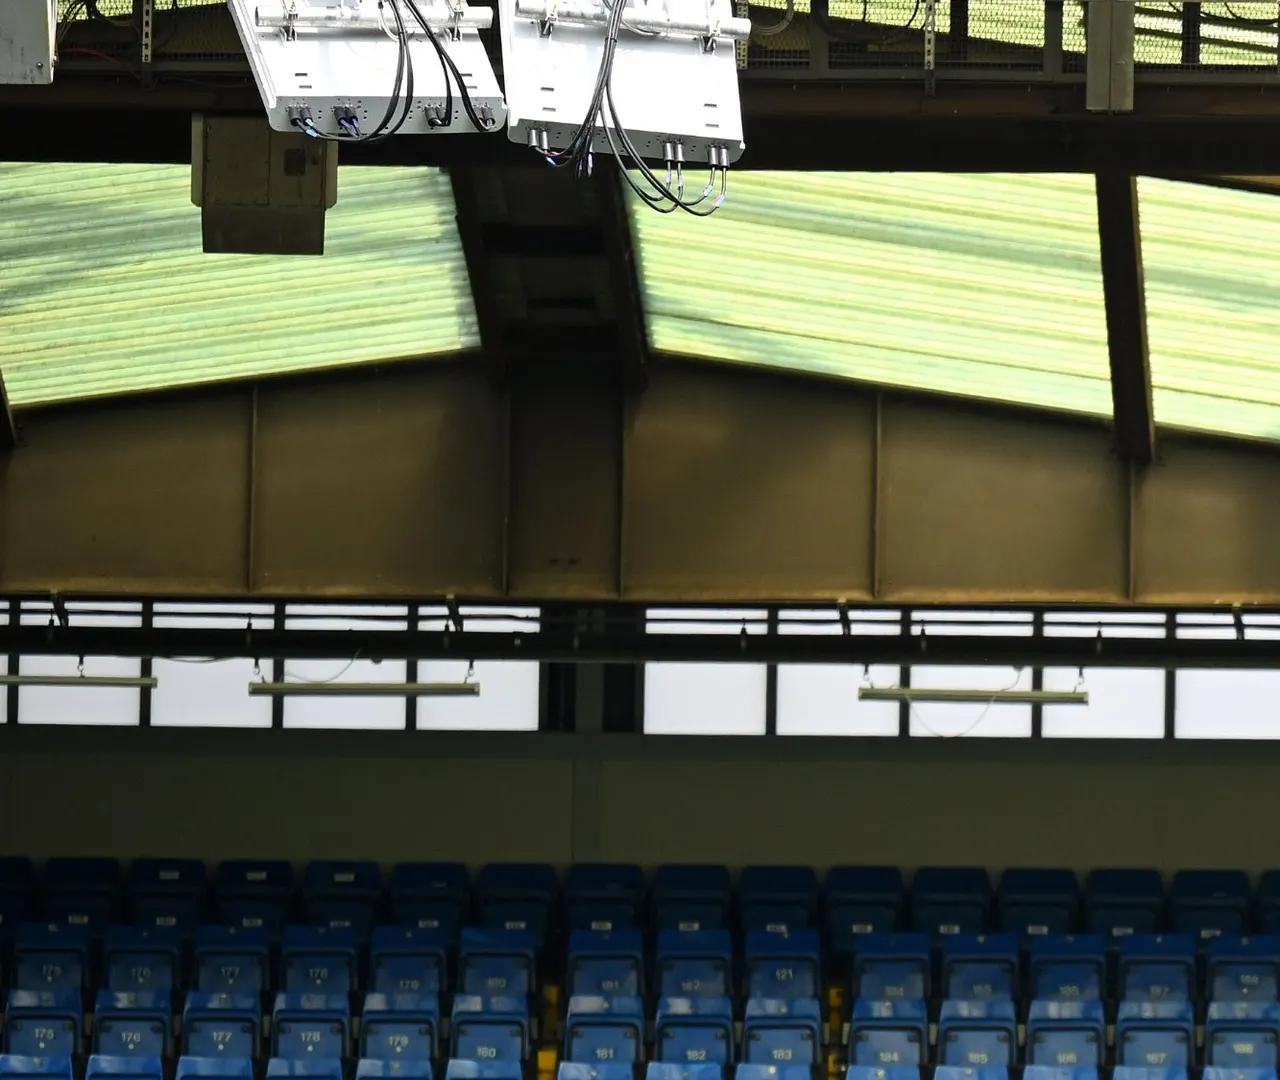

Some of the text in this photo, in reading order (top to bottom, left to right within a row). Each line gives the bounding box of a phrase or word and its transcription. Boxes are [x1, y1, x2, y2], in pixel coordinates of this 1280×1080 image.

[776, 969, 793, 979] 121
[213, 1032, 232, 1042] 177
[595, 1048, 613, 1059] 181
